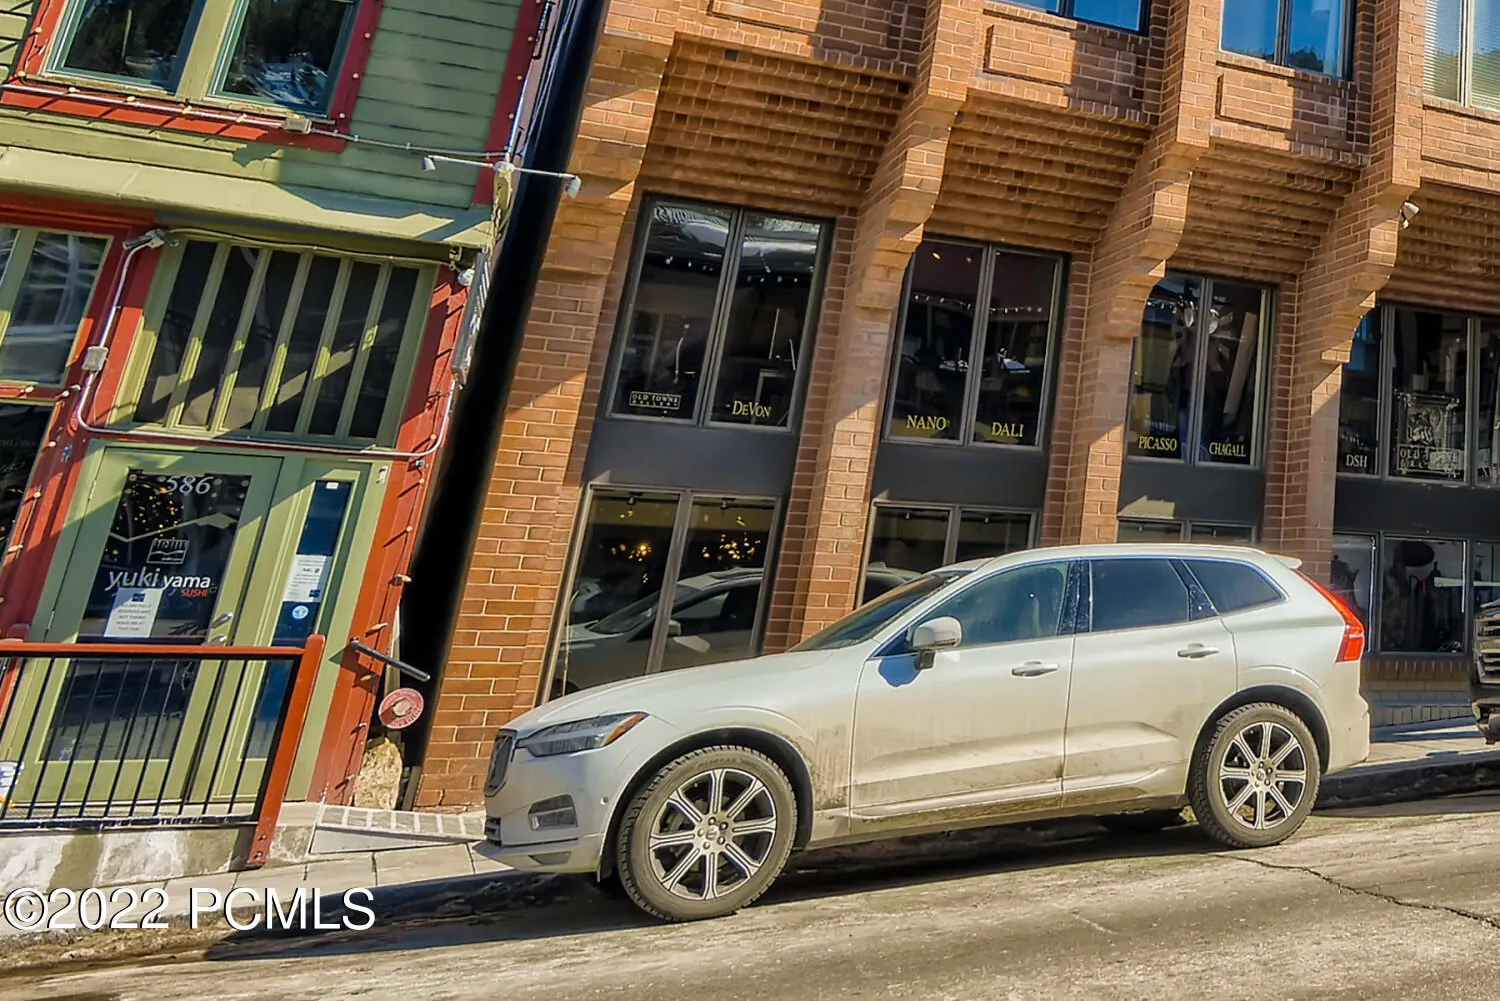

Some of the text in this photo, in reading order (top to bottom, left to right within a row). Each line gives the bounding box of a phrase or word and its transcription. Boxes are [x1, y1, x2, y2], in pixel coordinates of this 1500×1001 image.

[632, 393, 649, 401] OLD
[906, 414, 947, 431] NANO
[991, 422, 1025, 438] DALI
[1138, 435, 1178, 452] PICASSO
[1208, 442, 1247, 458] CHAGALL
[1345, 454, 1368, 469] DSH
[1400, 448, 1420, 459] OLD
[165, 475, 215, 495] 586
[105, 567, 211, 592] yuki yama
[180, 588, 209, 598] SUSHI
